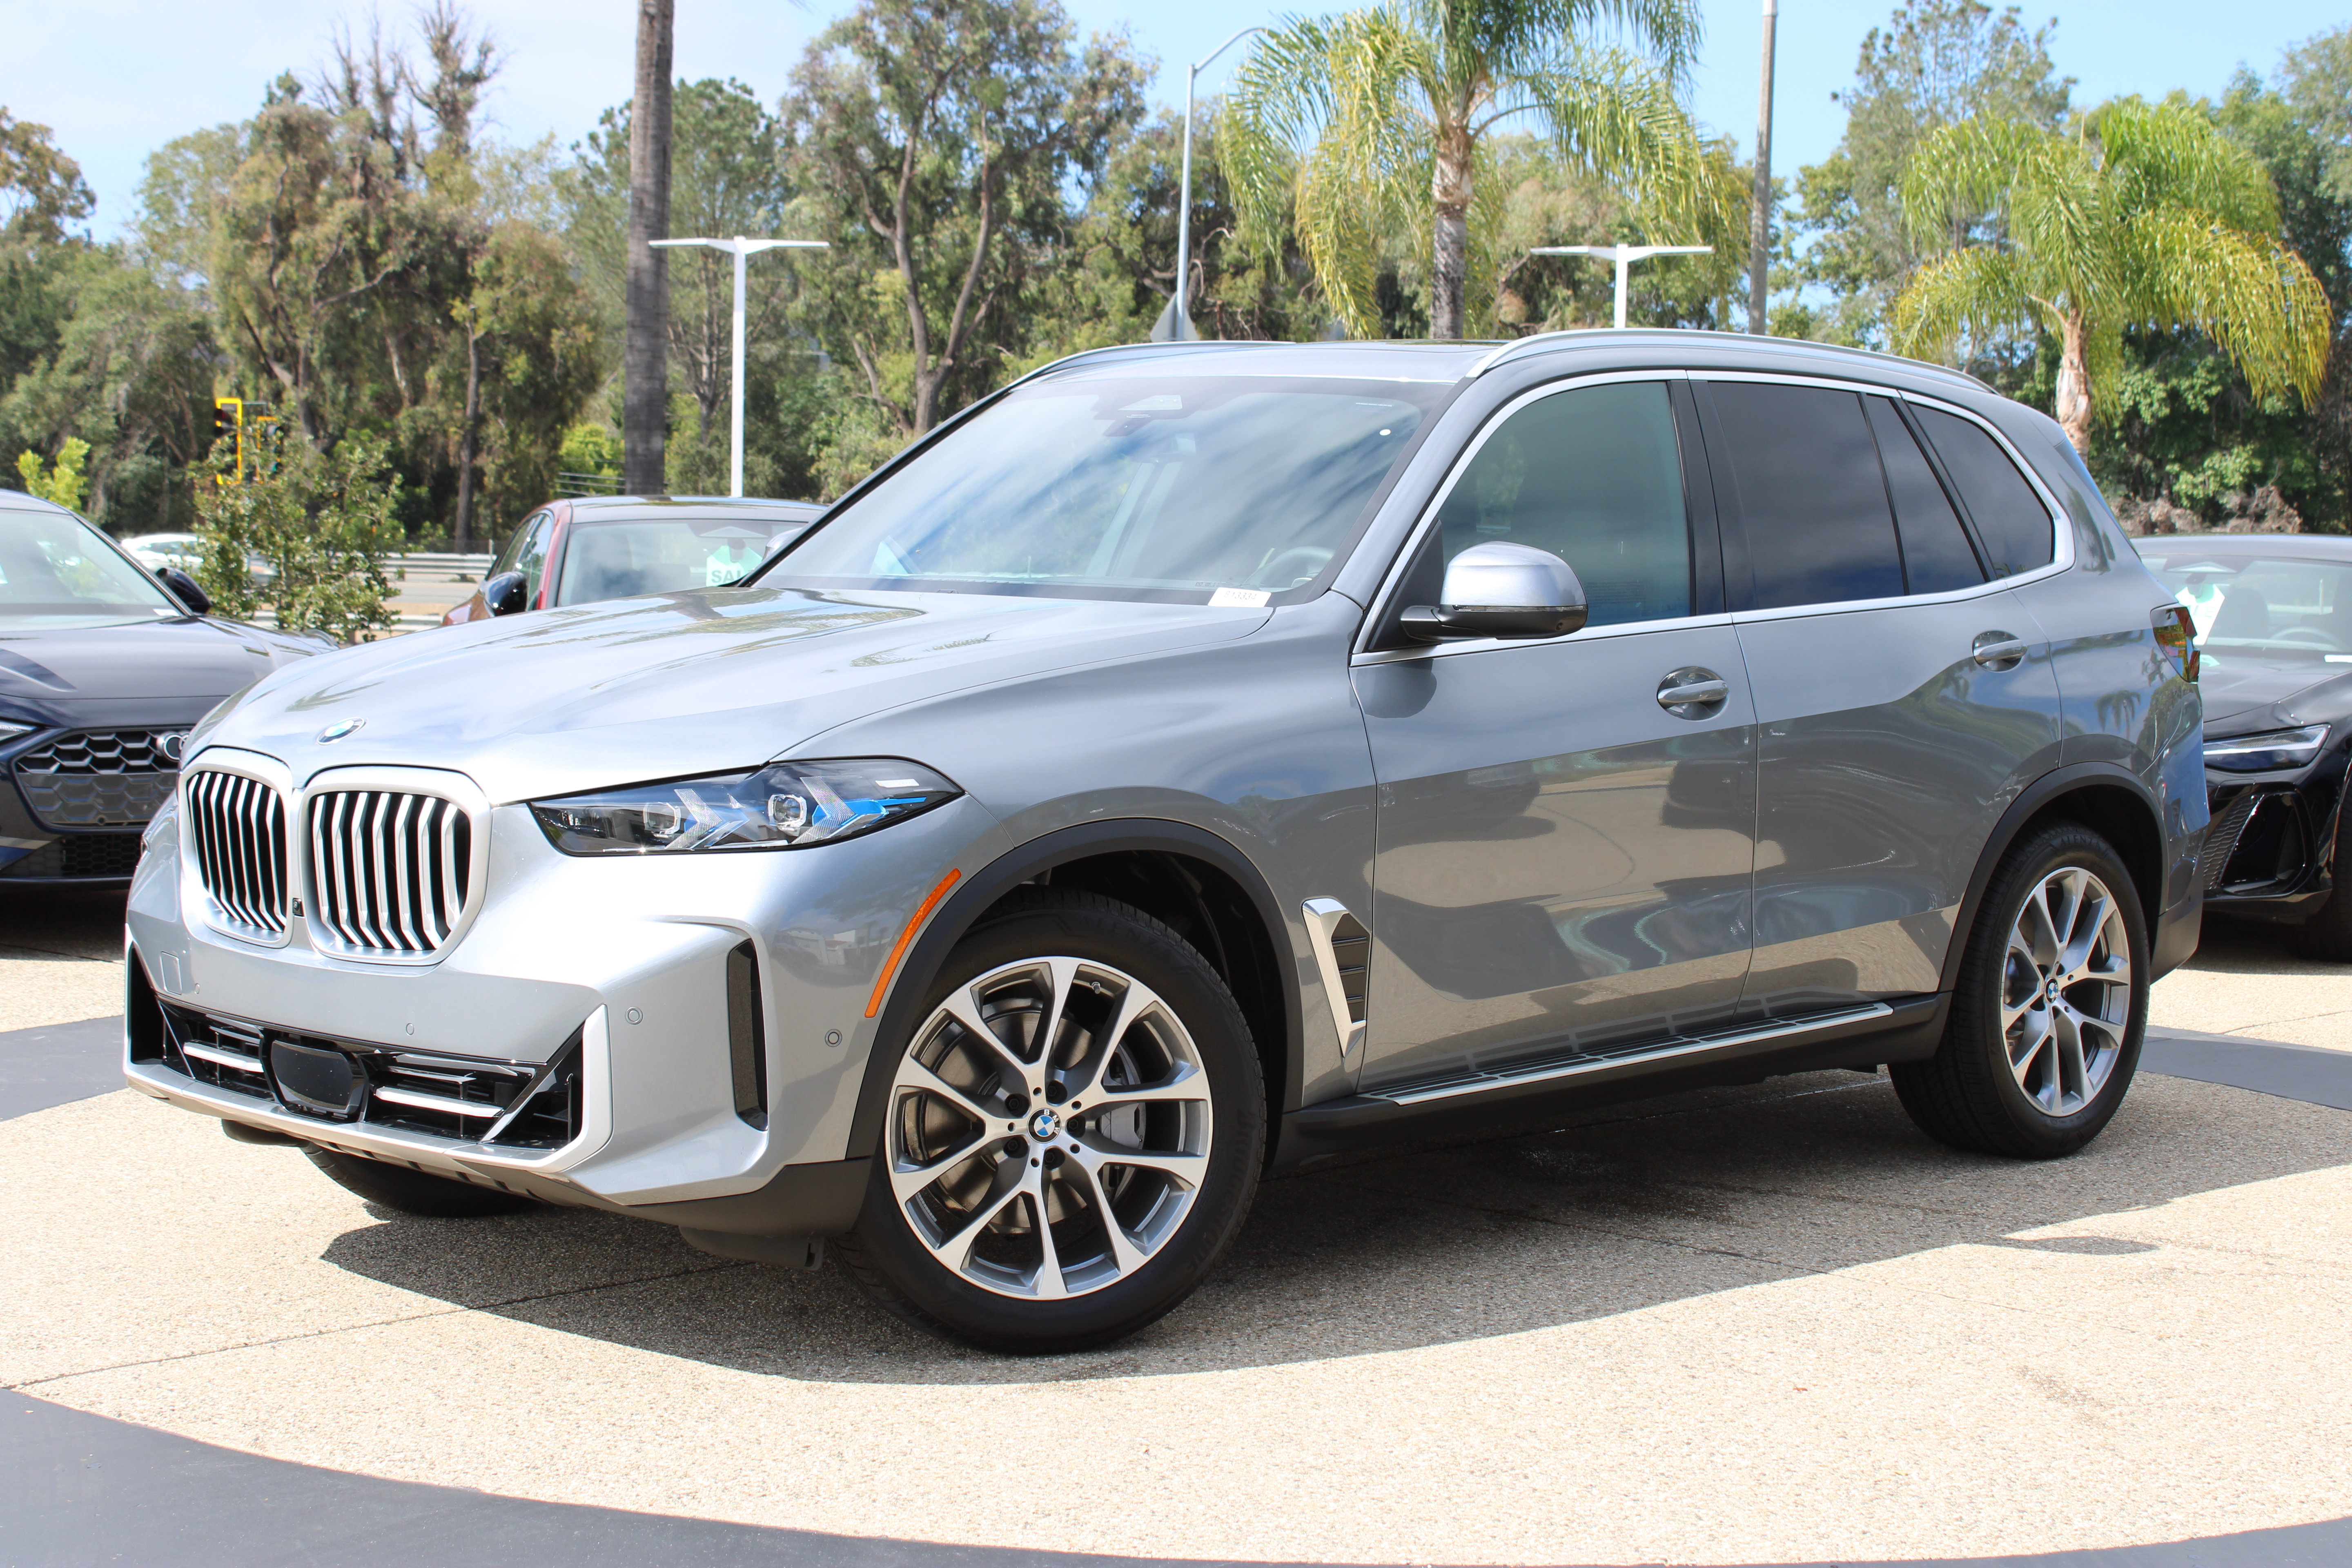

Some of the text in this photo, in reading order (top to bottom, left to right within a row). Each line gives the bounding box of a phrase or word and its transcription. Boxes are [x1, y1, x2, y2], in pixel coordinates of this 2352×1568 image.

[711, 569, 751, 584] SA
[2060, 835, 2101, 850] ALENZA
[1043, 1109, 1060, 1134] BMW
[1183, 1109, 1257, 1274] BRIDGESTONE
